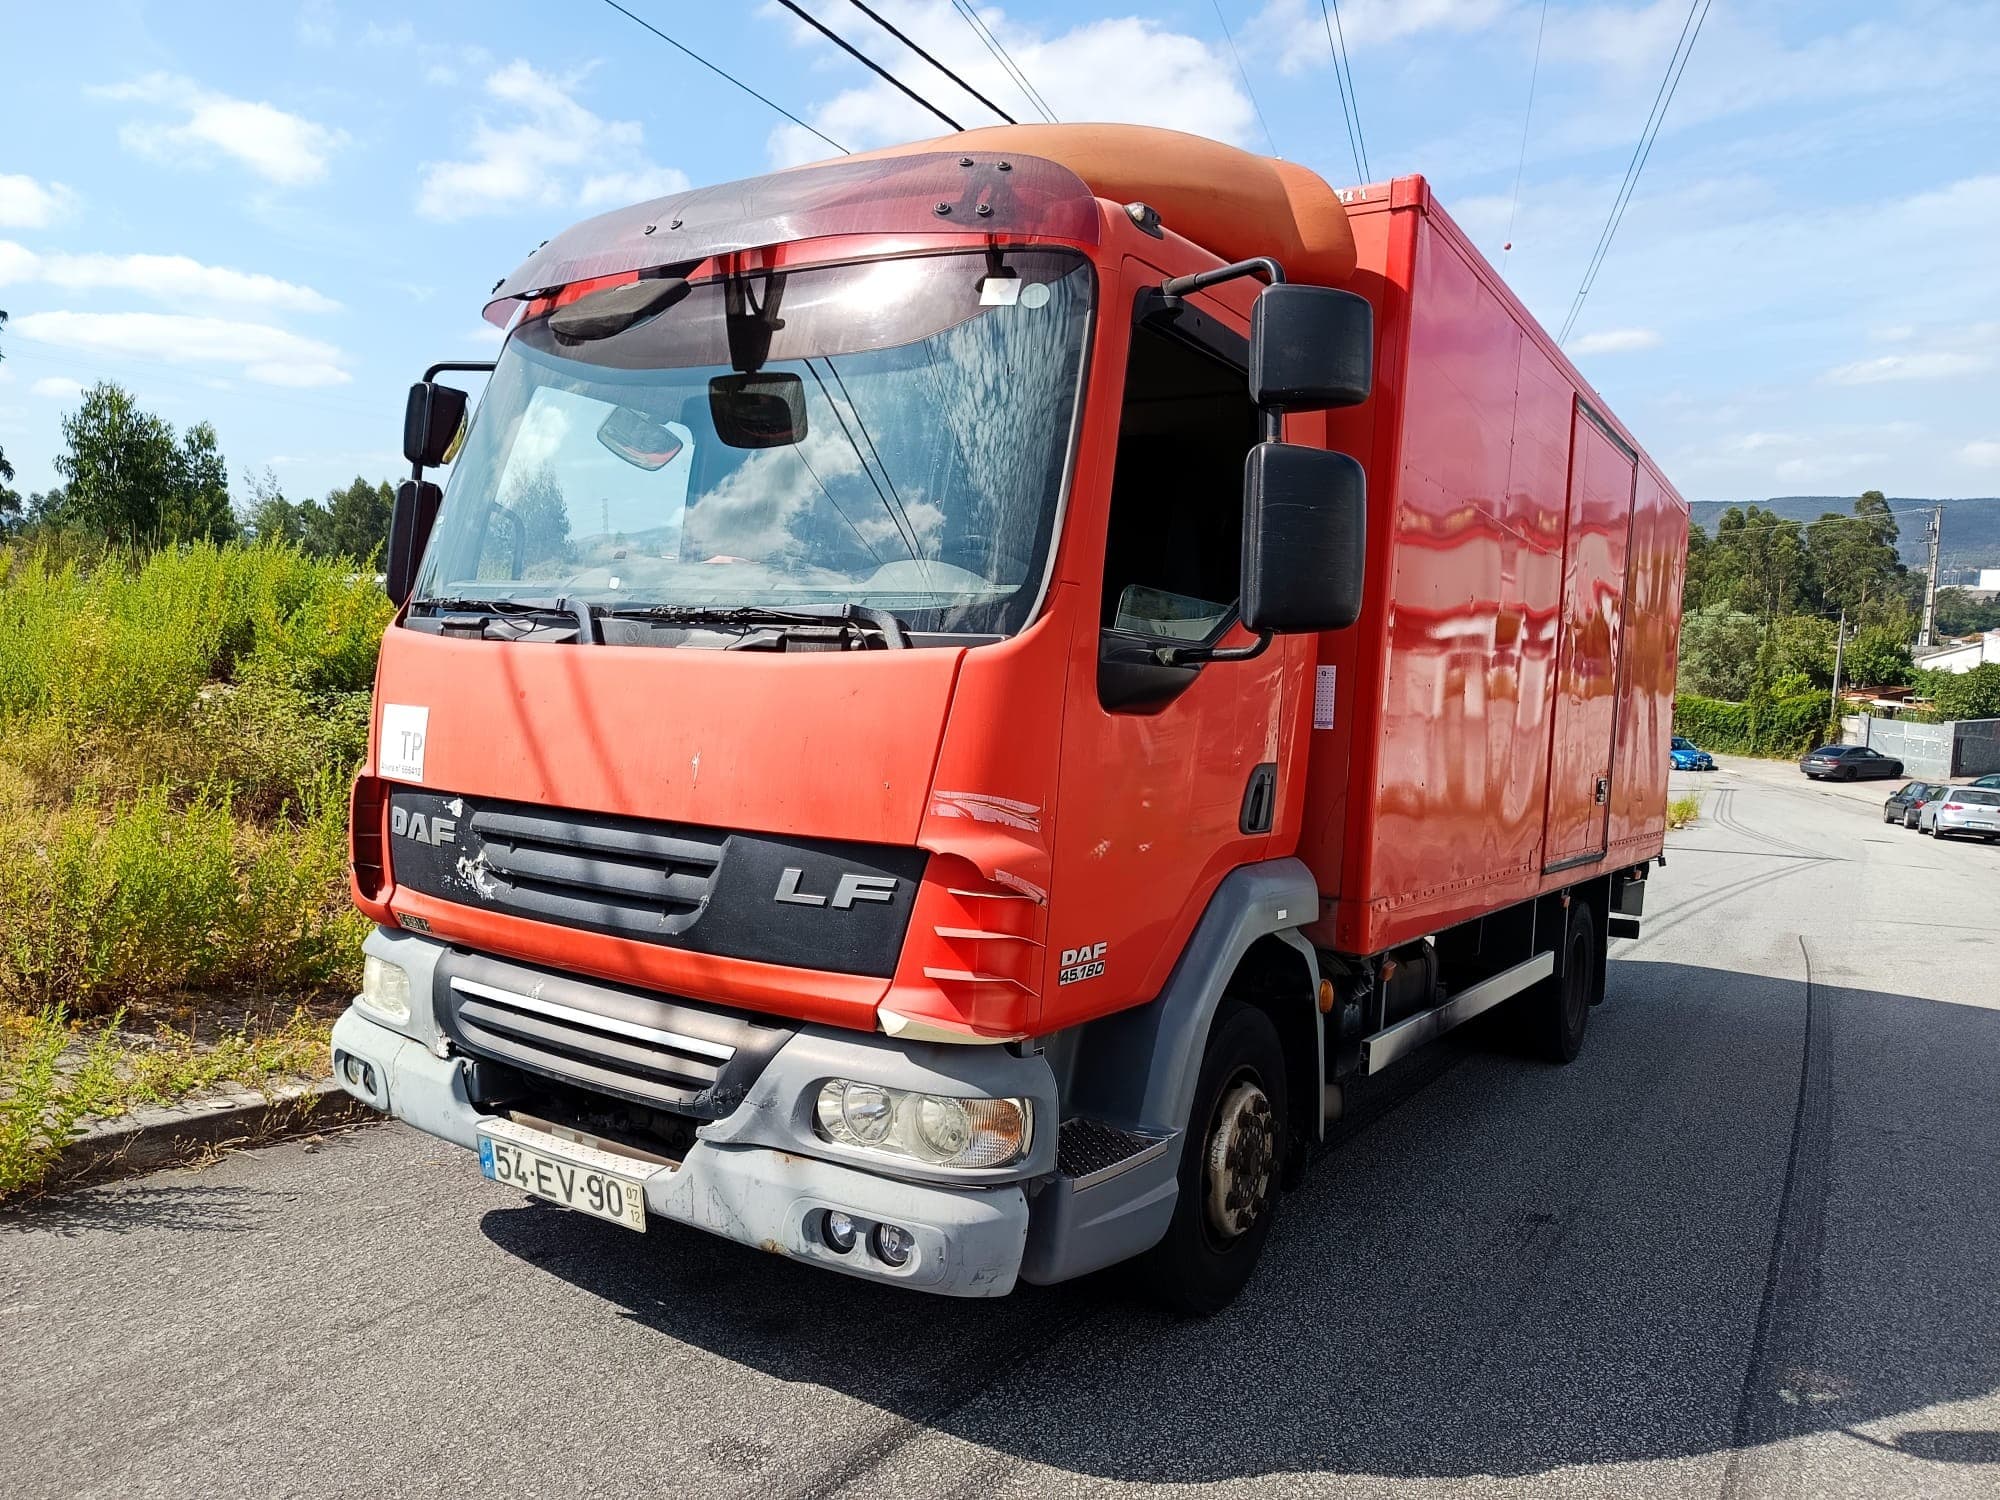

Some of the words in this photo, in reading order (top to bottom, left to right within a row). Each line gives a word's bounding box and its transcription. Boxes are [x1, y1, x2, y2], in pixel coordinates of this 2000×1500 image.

[401, 730, 423, 761] TP
[391, 805, 457, 848] DAF
[774, 868, 898, 909] LF
[1061, 941, 1108, 967] DAF
[1060, 961, 1105, 983] 45.180
[485, 1160, 492, 1171] P
[625, 1186, 639, 1201] 07
[629, 1208, 641, 1224] 12
